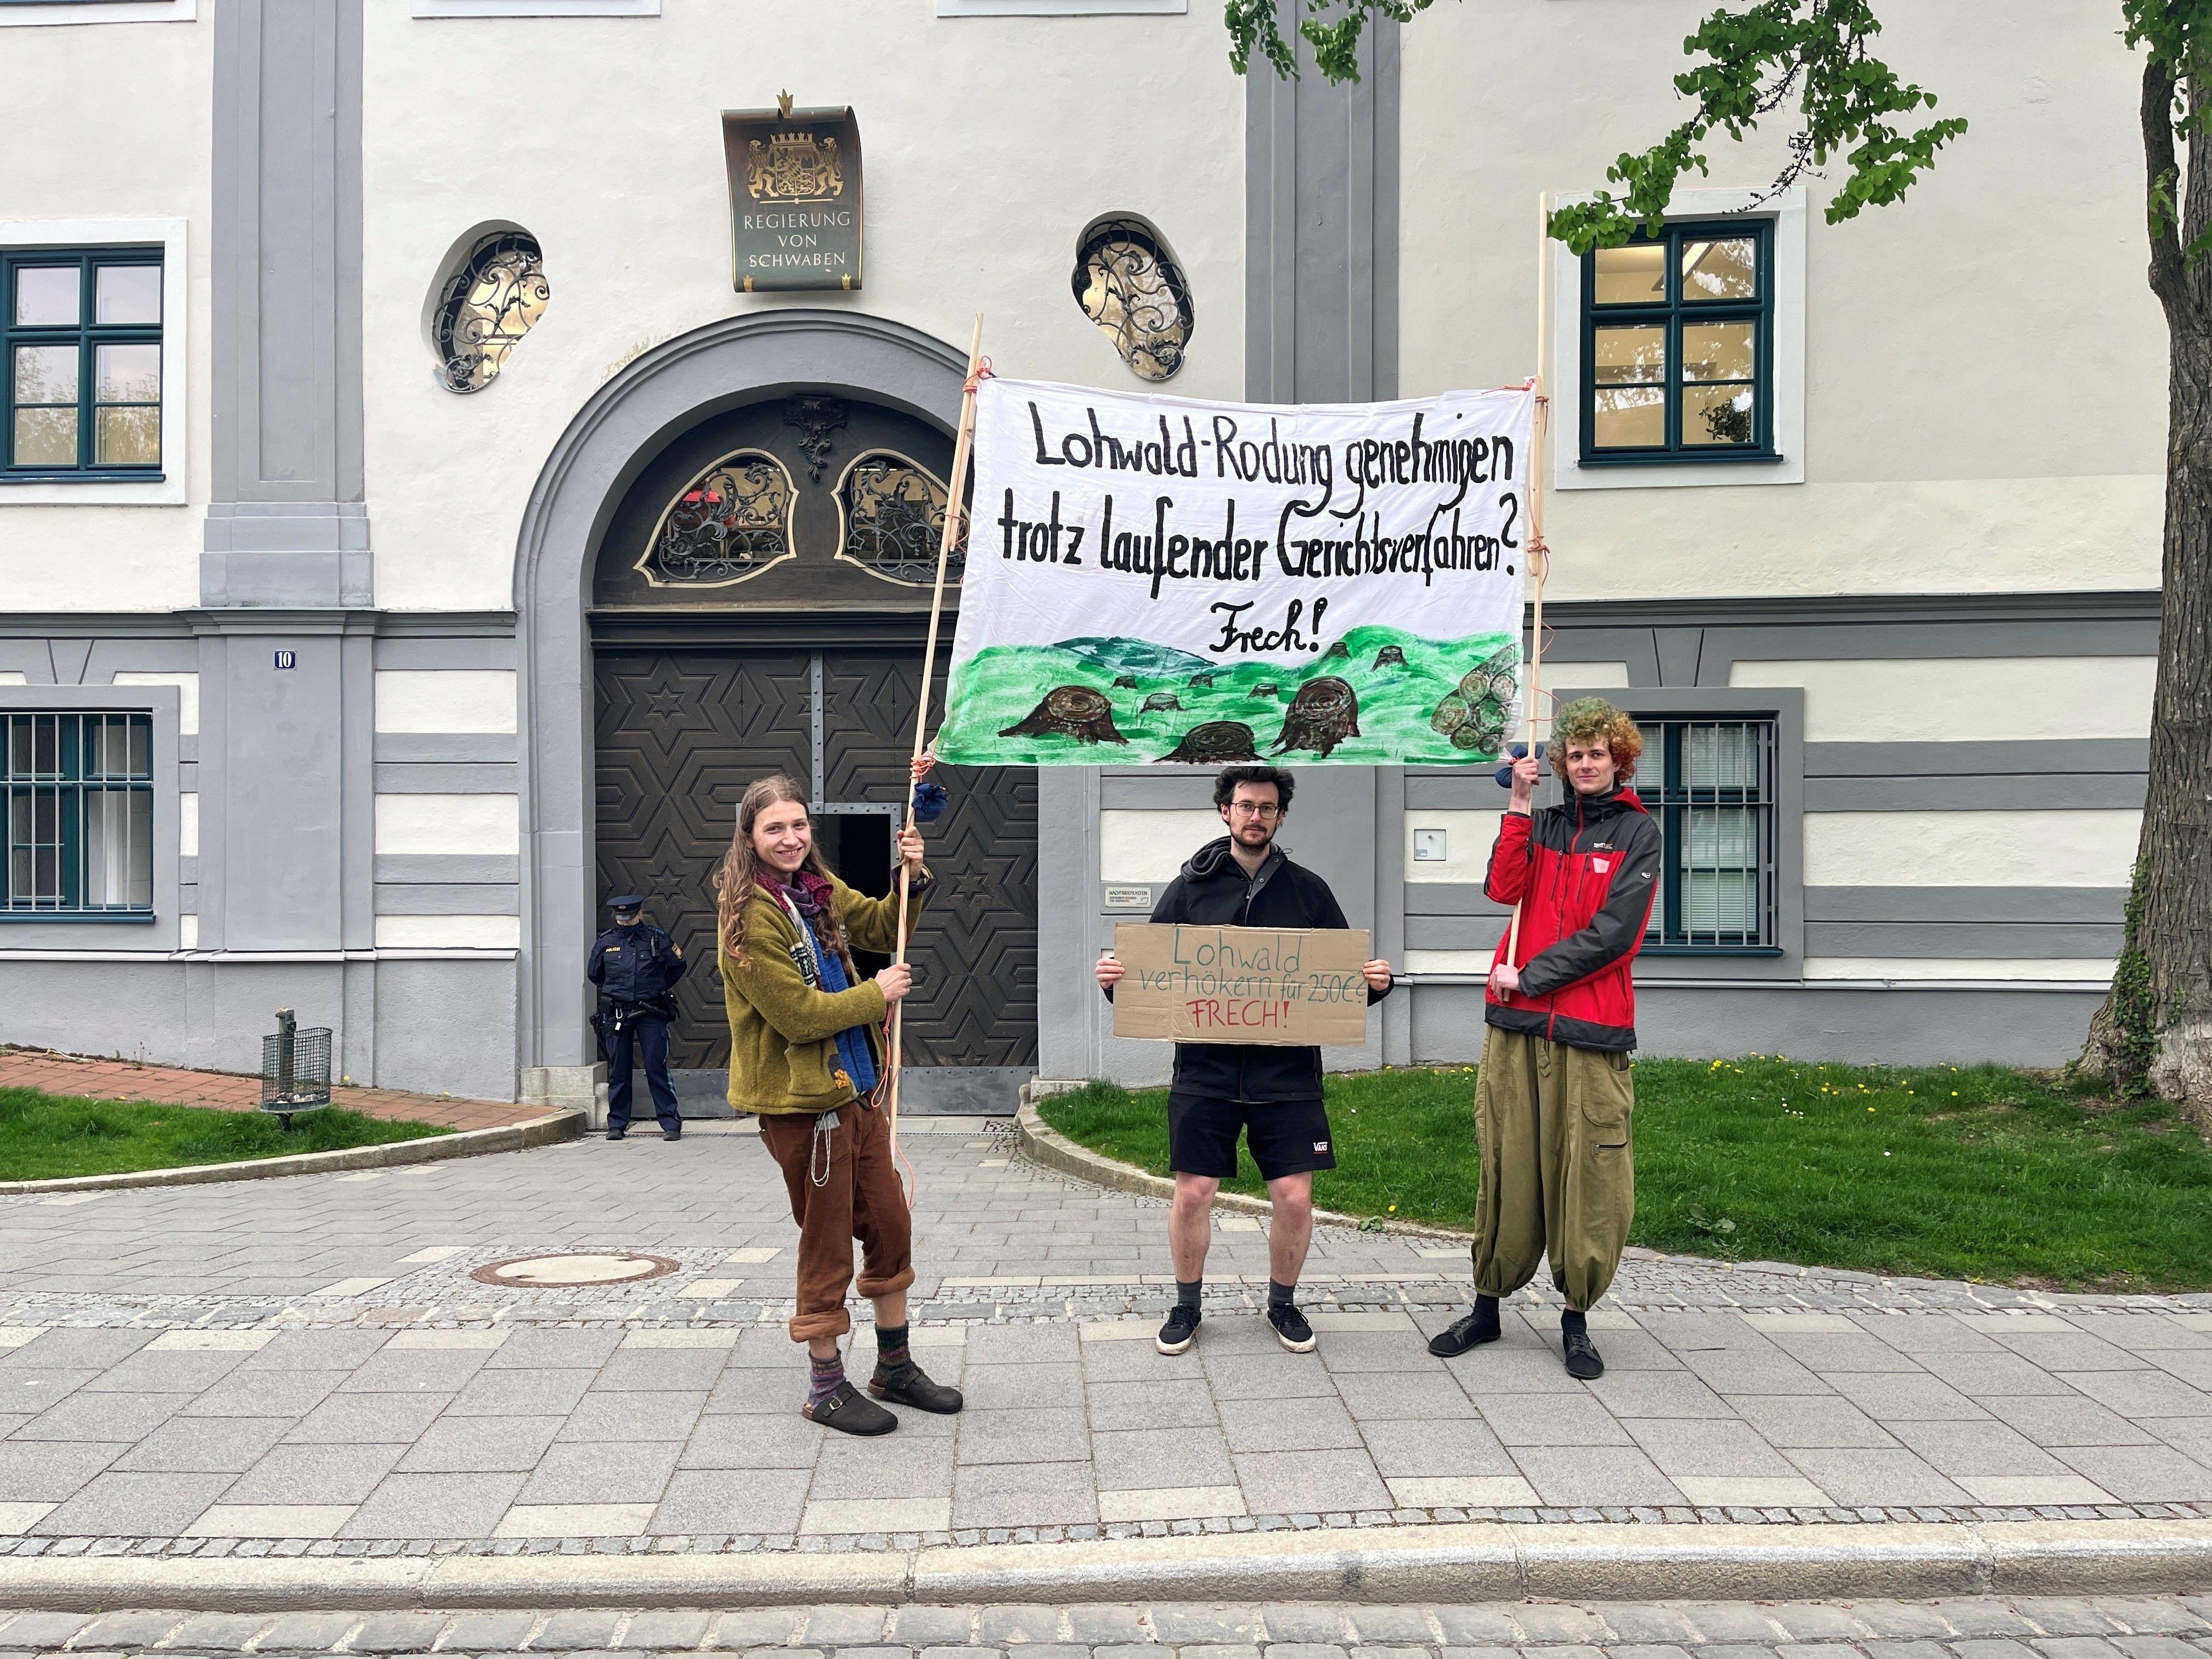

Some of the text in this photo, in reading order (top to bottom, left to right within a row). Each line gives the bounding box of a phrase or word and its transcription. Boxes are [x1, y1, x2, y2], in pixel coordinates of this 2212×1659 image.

[744, 211, 850, 229] REGIERUNG
[778, 235, 816, 247] VON
[749, 252, 845, 268] SCHWABEN
[1028, 400, 1513, 520] Lohwald-Rodung genehmigen
[997, 488, 1519, 599] trotz laufender Gerichtsverfahren?
[1209, 597, 1328, 653] Frech!
[278, 652, 291, 668] 10
[1174, 928, 1301, 973] Lohwald
[1140, 966, 1271, 997] verhökern
[1279, 973, 1303, 1001] für
[1186, 998, 1289, 1028] FRECH!
[1313, 1142, 1328, 1152] VANS
